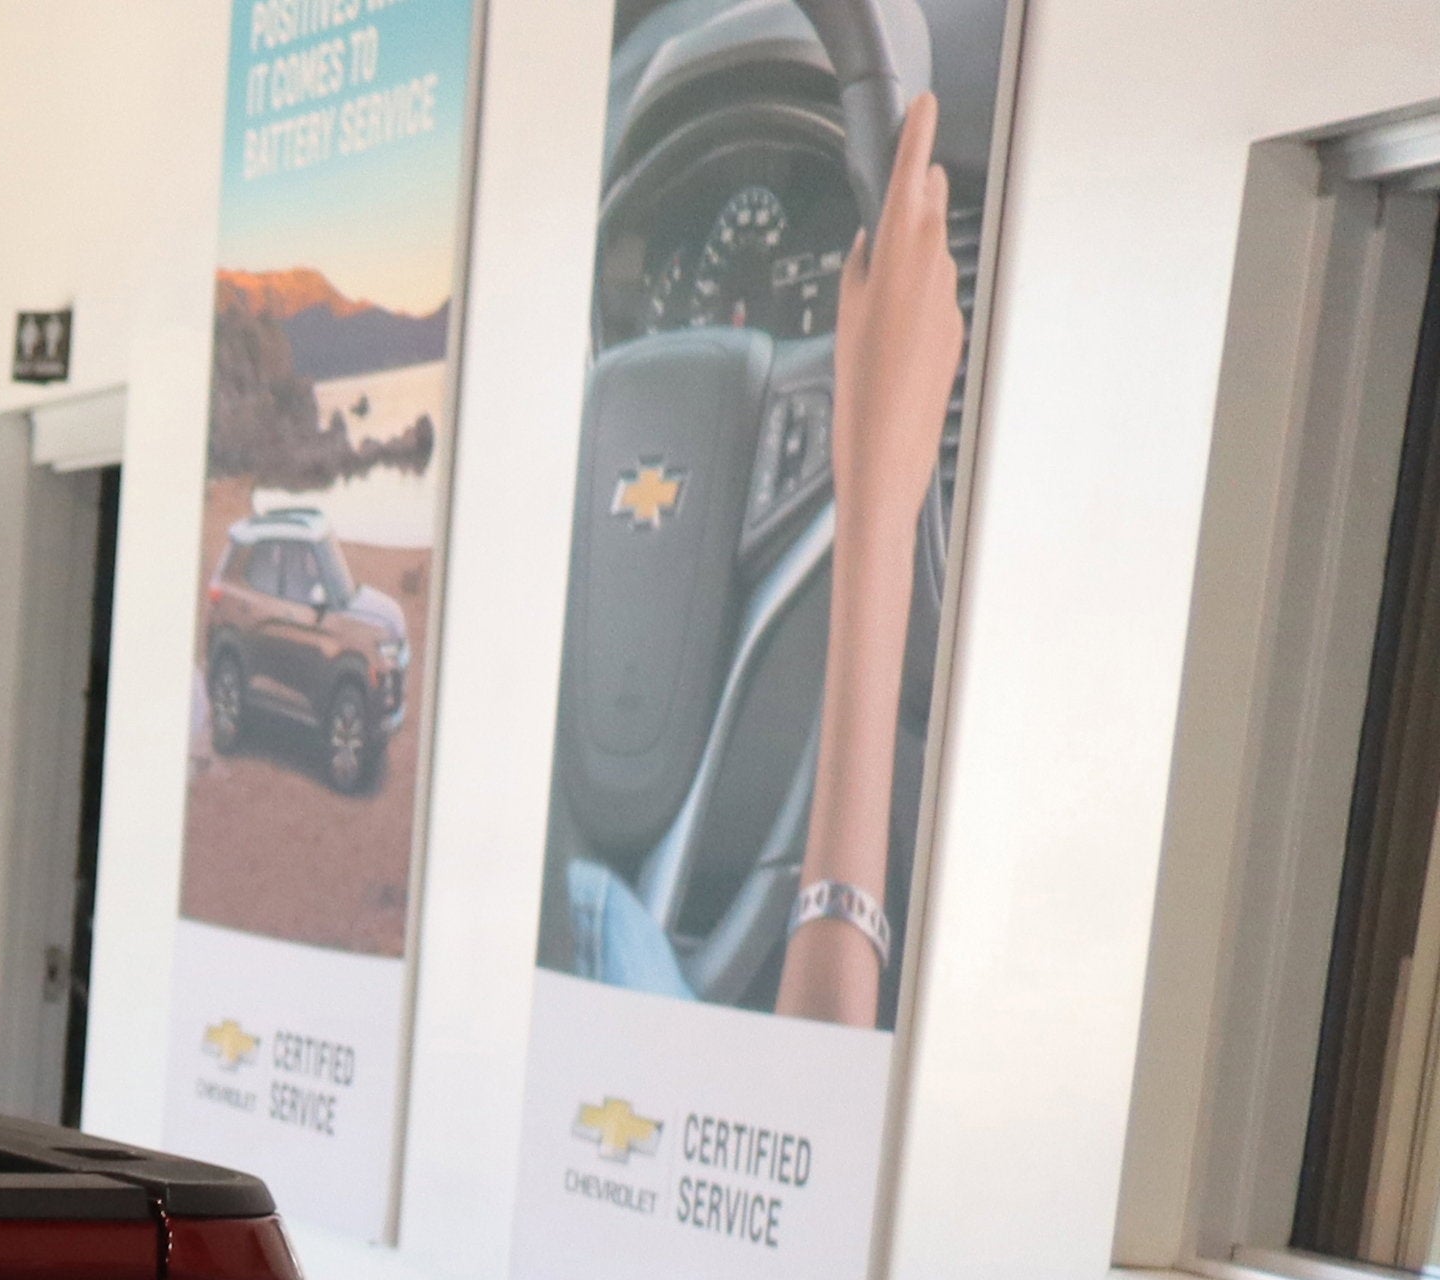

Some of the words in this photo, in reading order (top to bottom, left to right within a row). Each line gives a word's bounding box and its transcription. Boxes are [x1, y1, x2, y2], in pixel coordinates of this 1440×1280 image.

[245, 62, 269, 117] IT
[270, 37, 345, 110] COMES
[349, 25, 378, 84] TO
[244, 105, 337, 181] BATTERY
[338, 73, 439, 155] SERVICE
[273, 1029, 355, 1086] CERTIFIED
[270, 1079, 336, 1136] SERVICE
[682, 1112, 813, 1187] CERTIFIED
[564, 1167, 657, 1214] CHEVROLET
[676, 1174, 782, 1248] SERVICE
